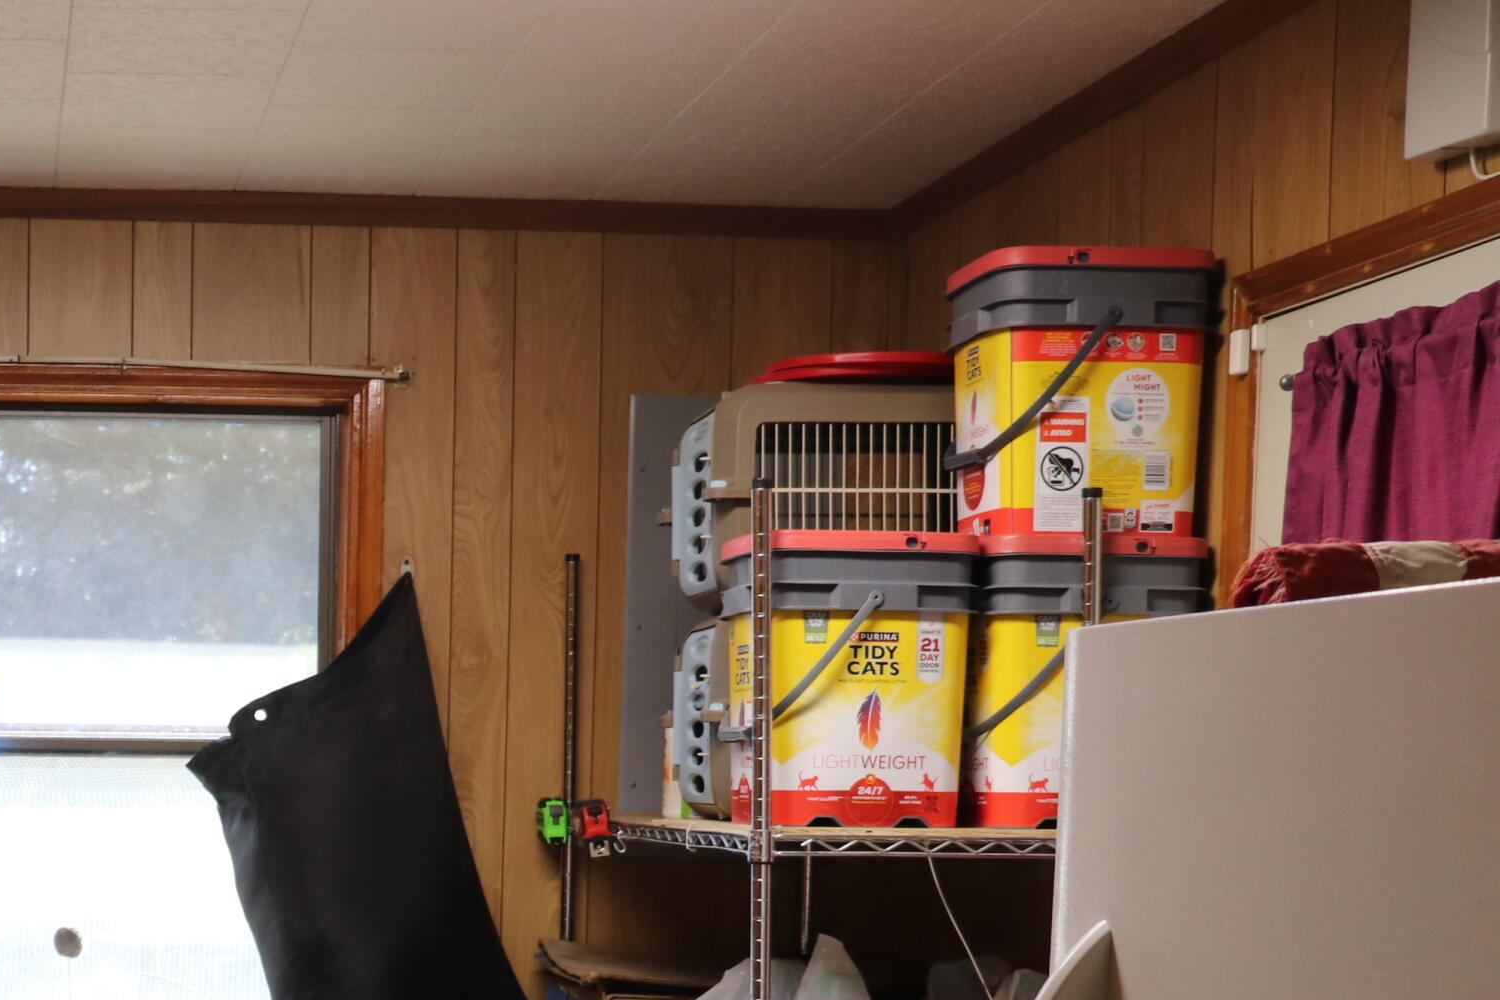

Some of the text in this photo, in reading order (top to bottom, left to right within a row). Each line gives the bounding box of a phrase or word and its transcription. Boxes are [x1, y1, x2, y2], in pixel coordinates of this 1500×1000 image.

[1126, 374, 1152, 382] LIGHT
[1134, 383, 1161, 391] MIGHT
[860, 633, 898, 641] PURINA
[921, 638, 940, 652] 21
[849, 645, 898, 659] TIDY
[847, 661, 900, 676] CATS
[813, 754, 926, 769] LIGHTWEIGHT
[857, 786, 884, 795] 24/7
